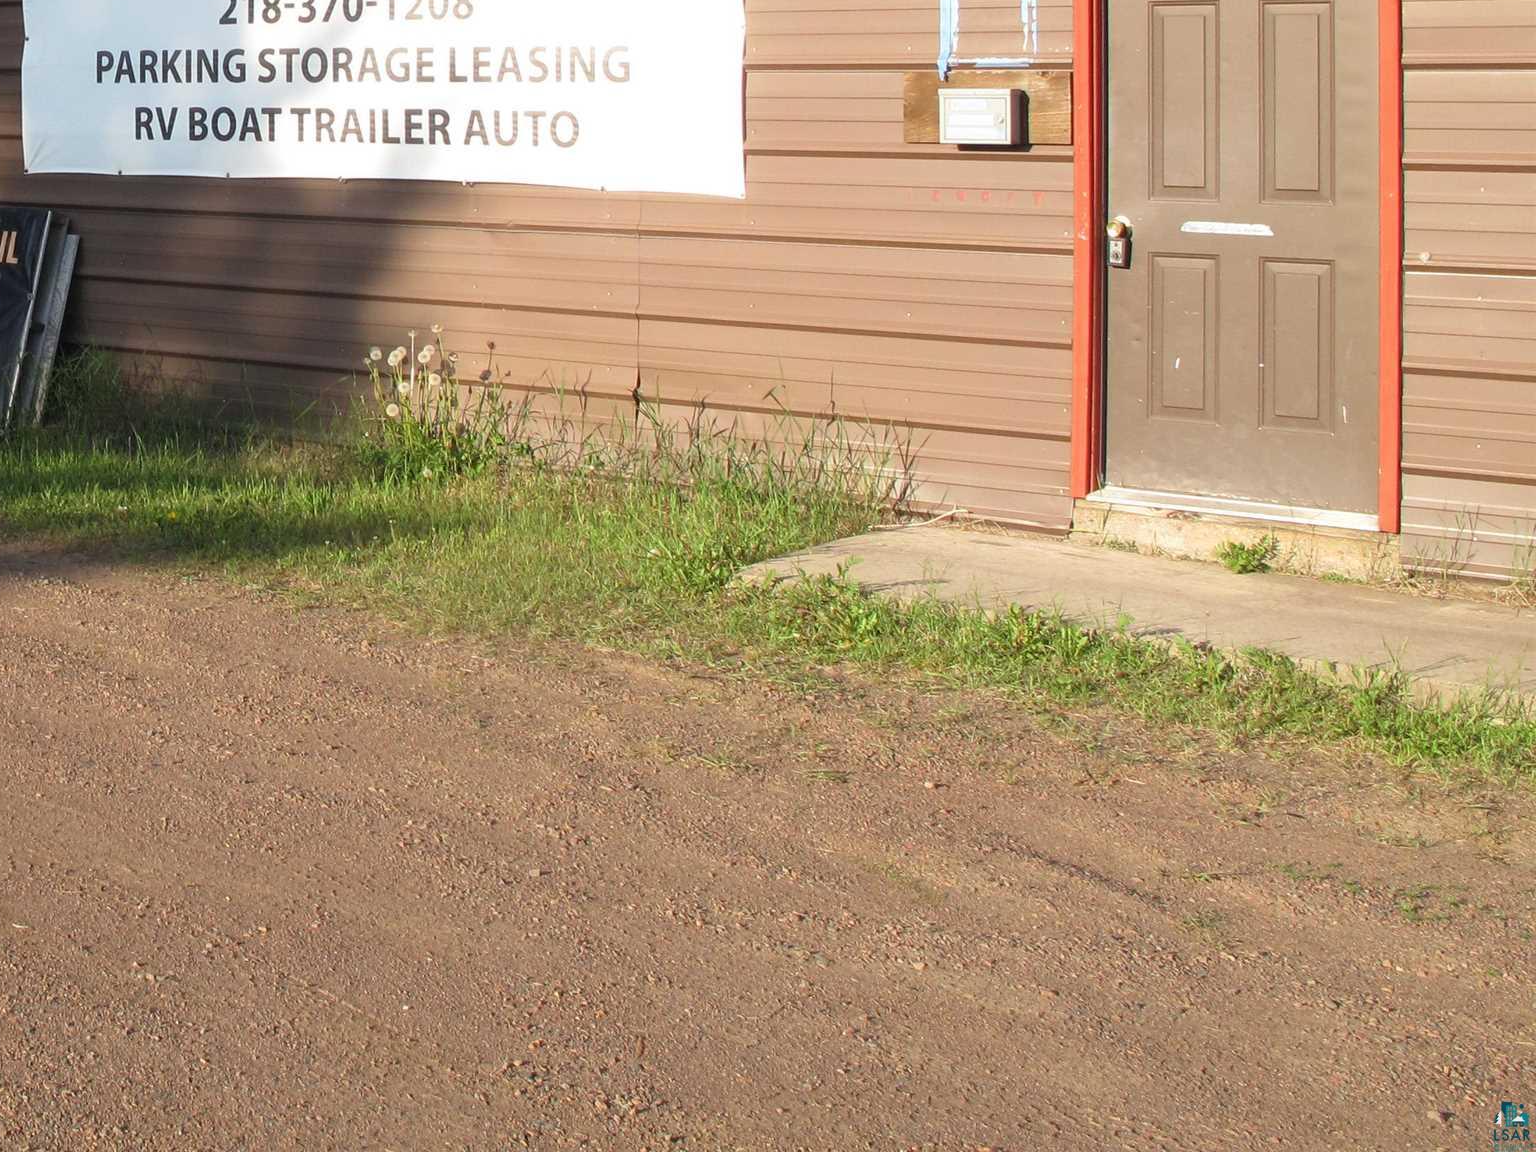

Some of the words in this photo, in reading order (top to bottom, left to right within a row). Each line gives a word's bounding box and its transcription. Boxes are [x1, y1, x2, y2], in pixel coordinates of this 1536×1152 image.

[96, 48, 247, 84] PARKING
[257, 46, 435, 83] STORAGE
[448, 45, 631, 83] LEASING
[134, 106, 178, 141] RV
[188, 106, 282, 143] BOAT
[290, 107, 452, 145] TRAILER
[463, 109, 580, 149] AUTO
